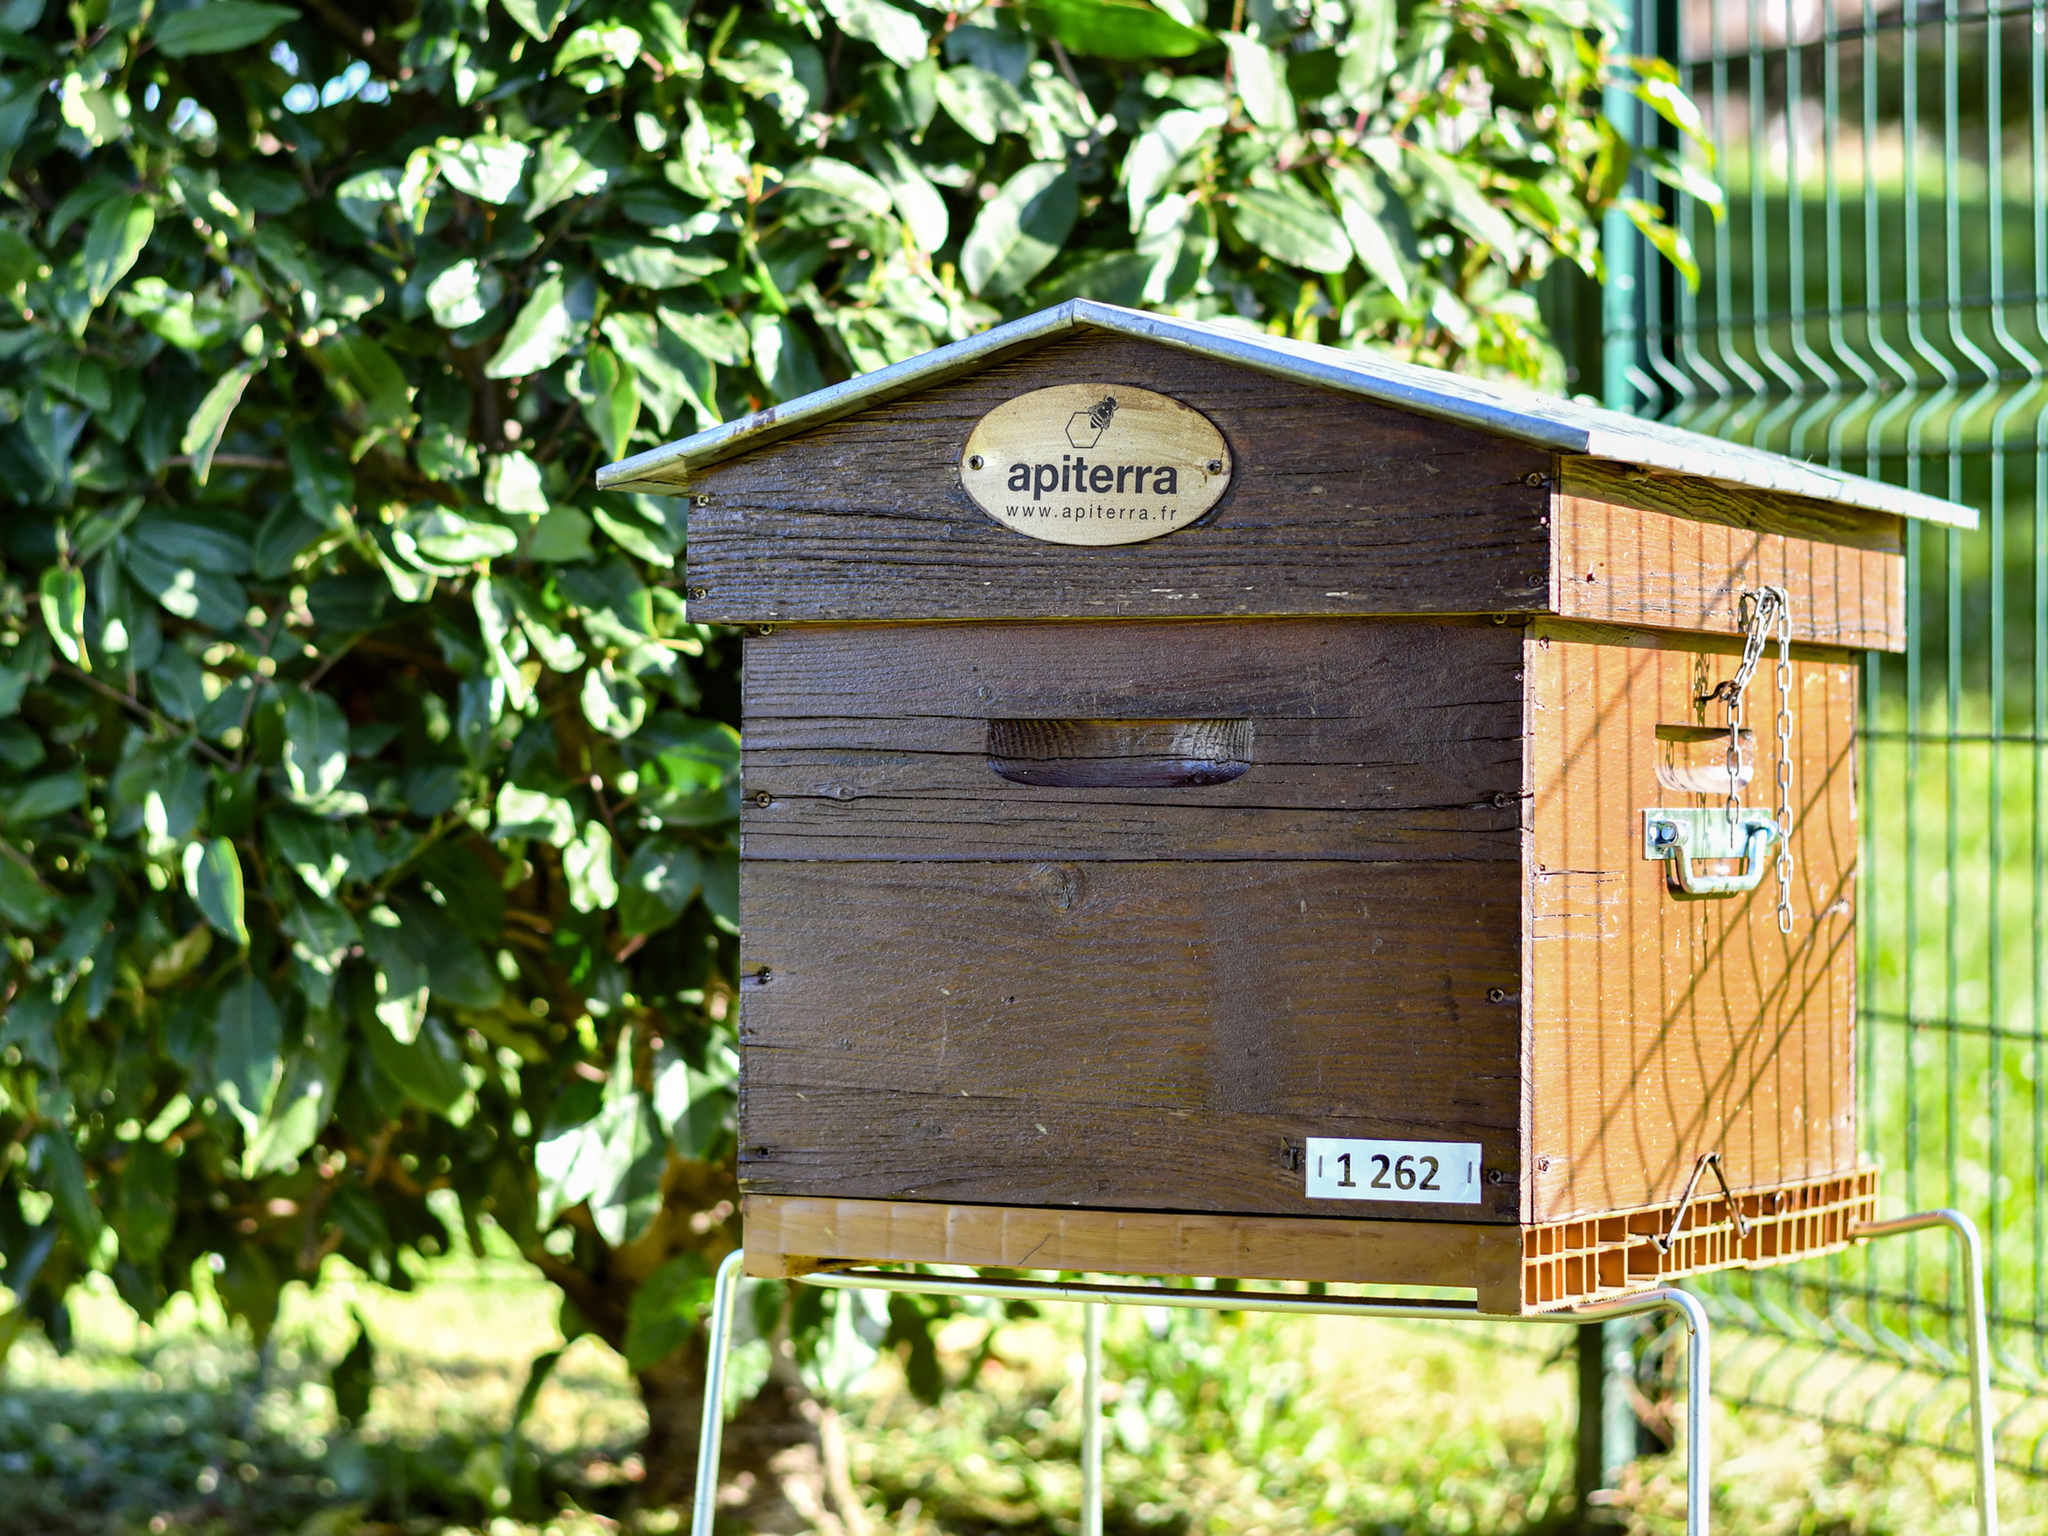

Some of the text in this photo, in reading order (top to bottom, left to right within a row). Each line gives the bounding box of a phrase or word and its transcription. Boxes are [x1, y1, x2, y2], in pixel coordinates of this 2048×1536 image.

[1007, 455, 1177, 500] apiterra
[1005, 504, 1177, 522] www.apiterra.fr
[1336, 1152, 1441, 1191] 1 262
